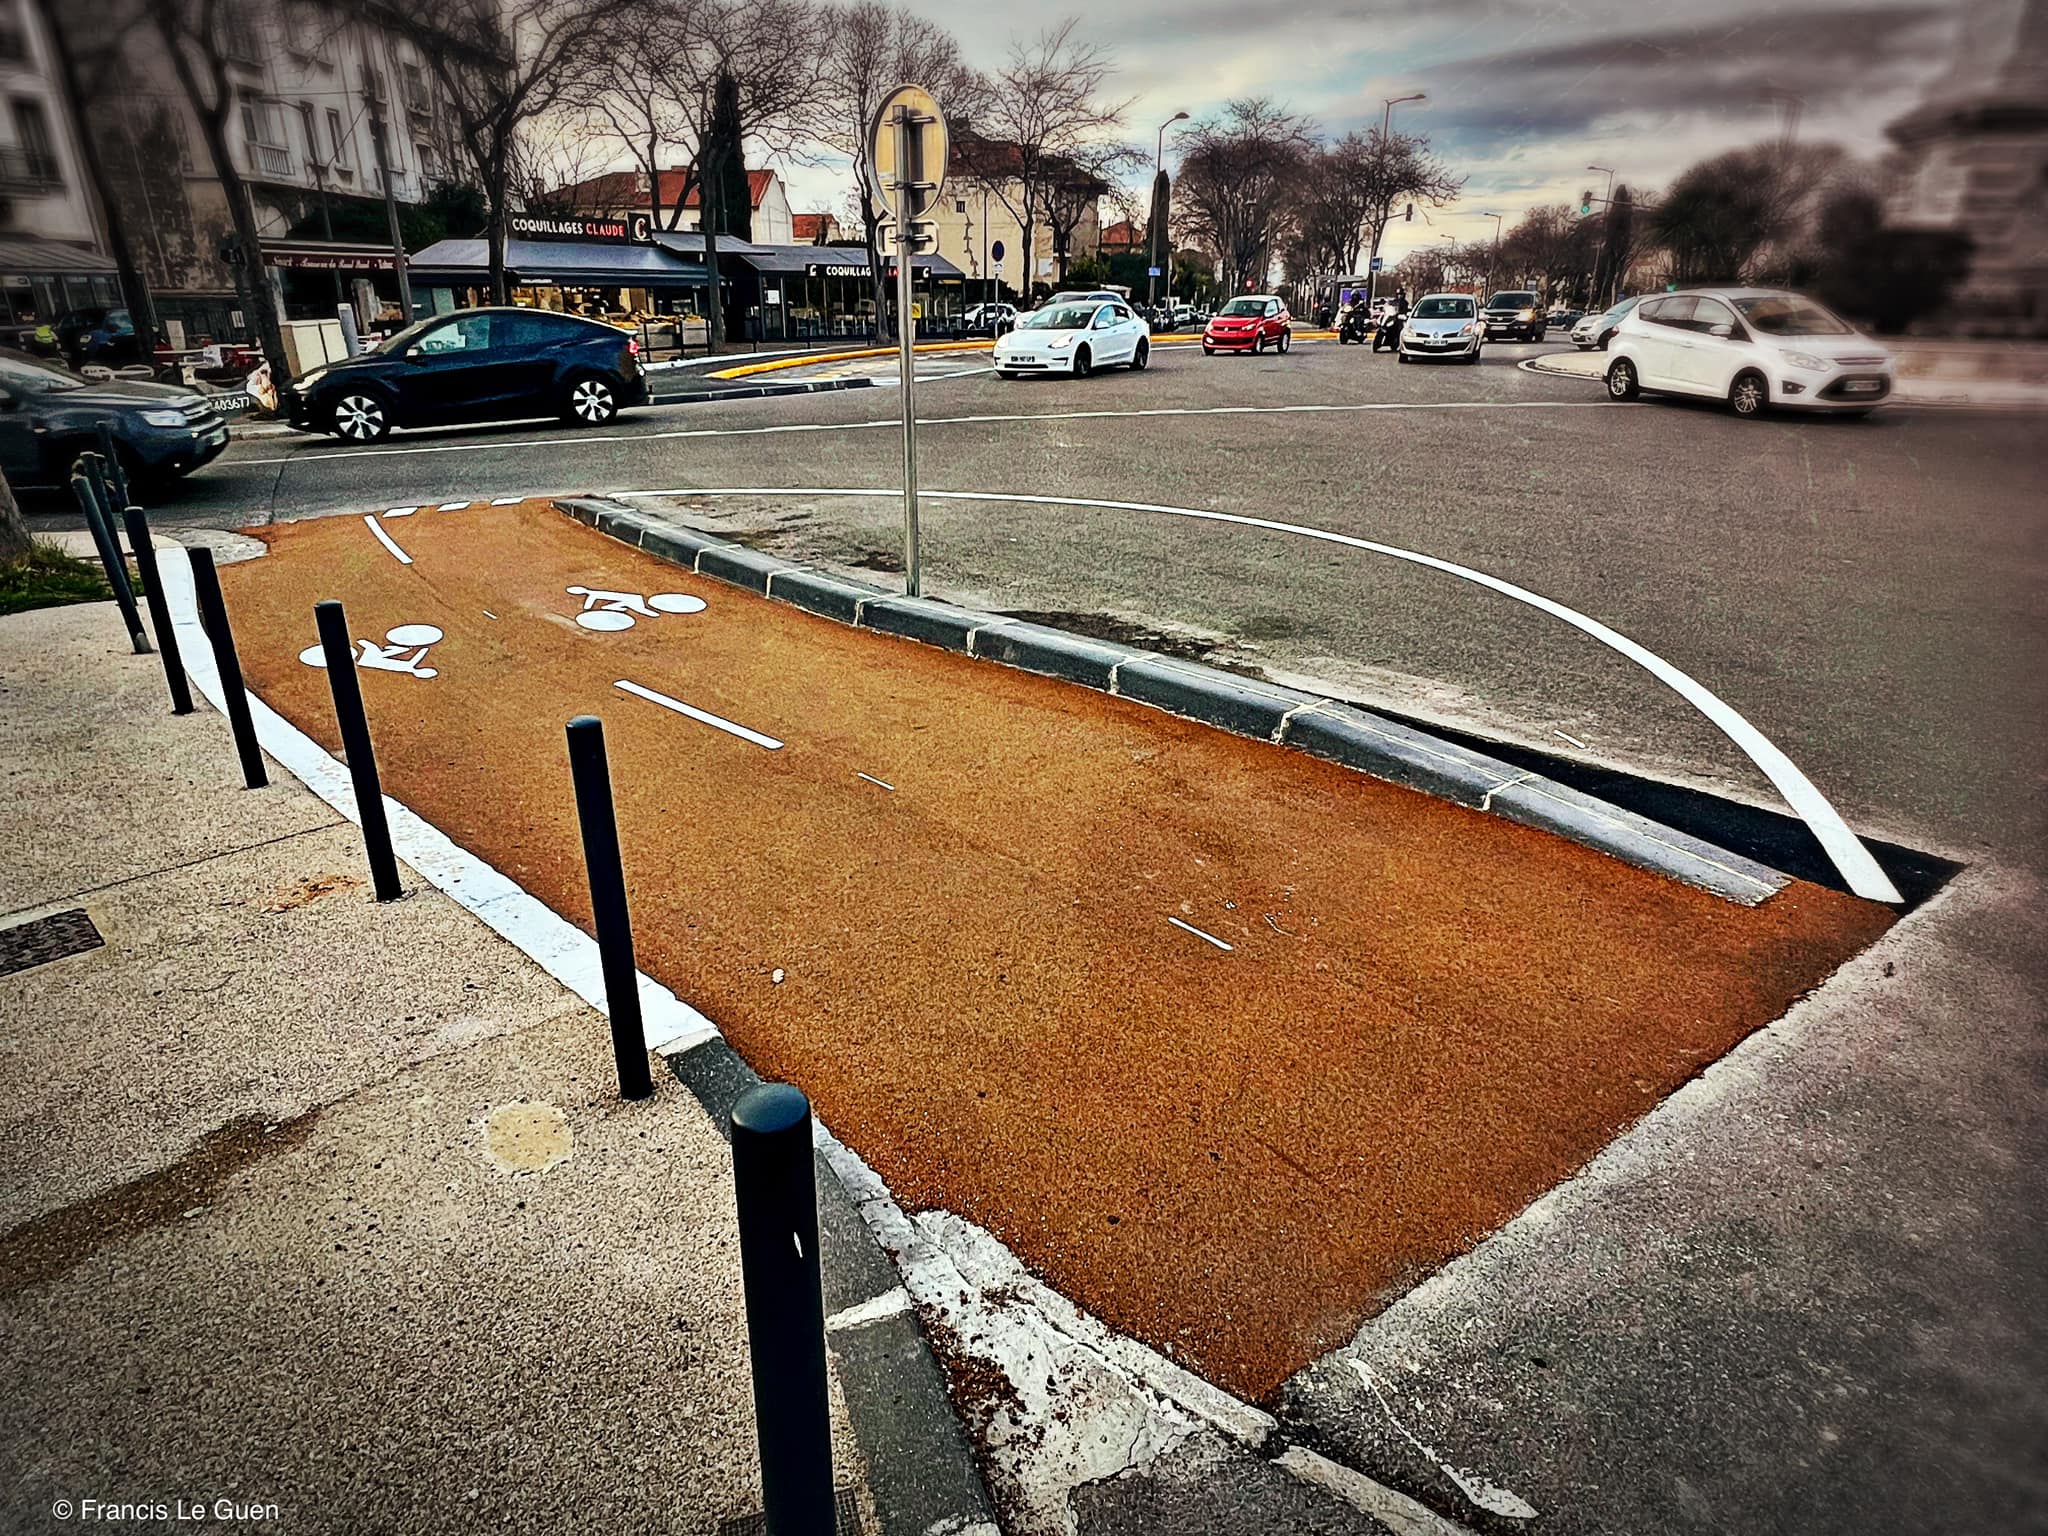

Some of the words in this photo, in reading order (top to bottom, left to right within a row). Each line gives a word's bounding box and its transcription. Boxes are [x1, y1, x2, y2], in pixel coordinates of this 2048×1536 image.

[512, 219, 583, 234] COQUILLAGES
[586, 223, 624, 237] CLAUDE
[826, 265, 872, 277] COQUILLAG
